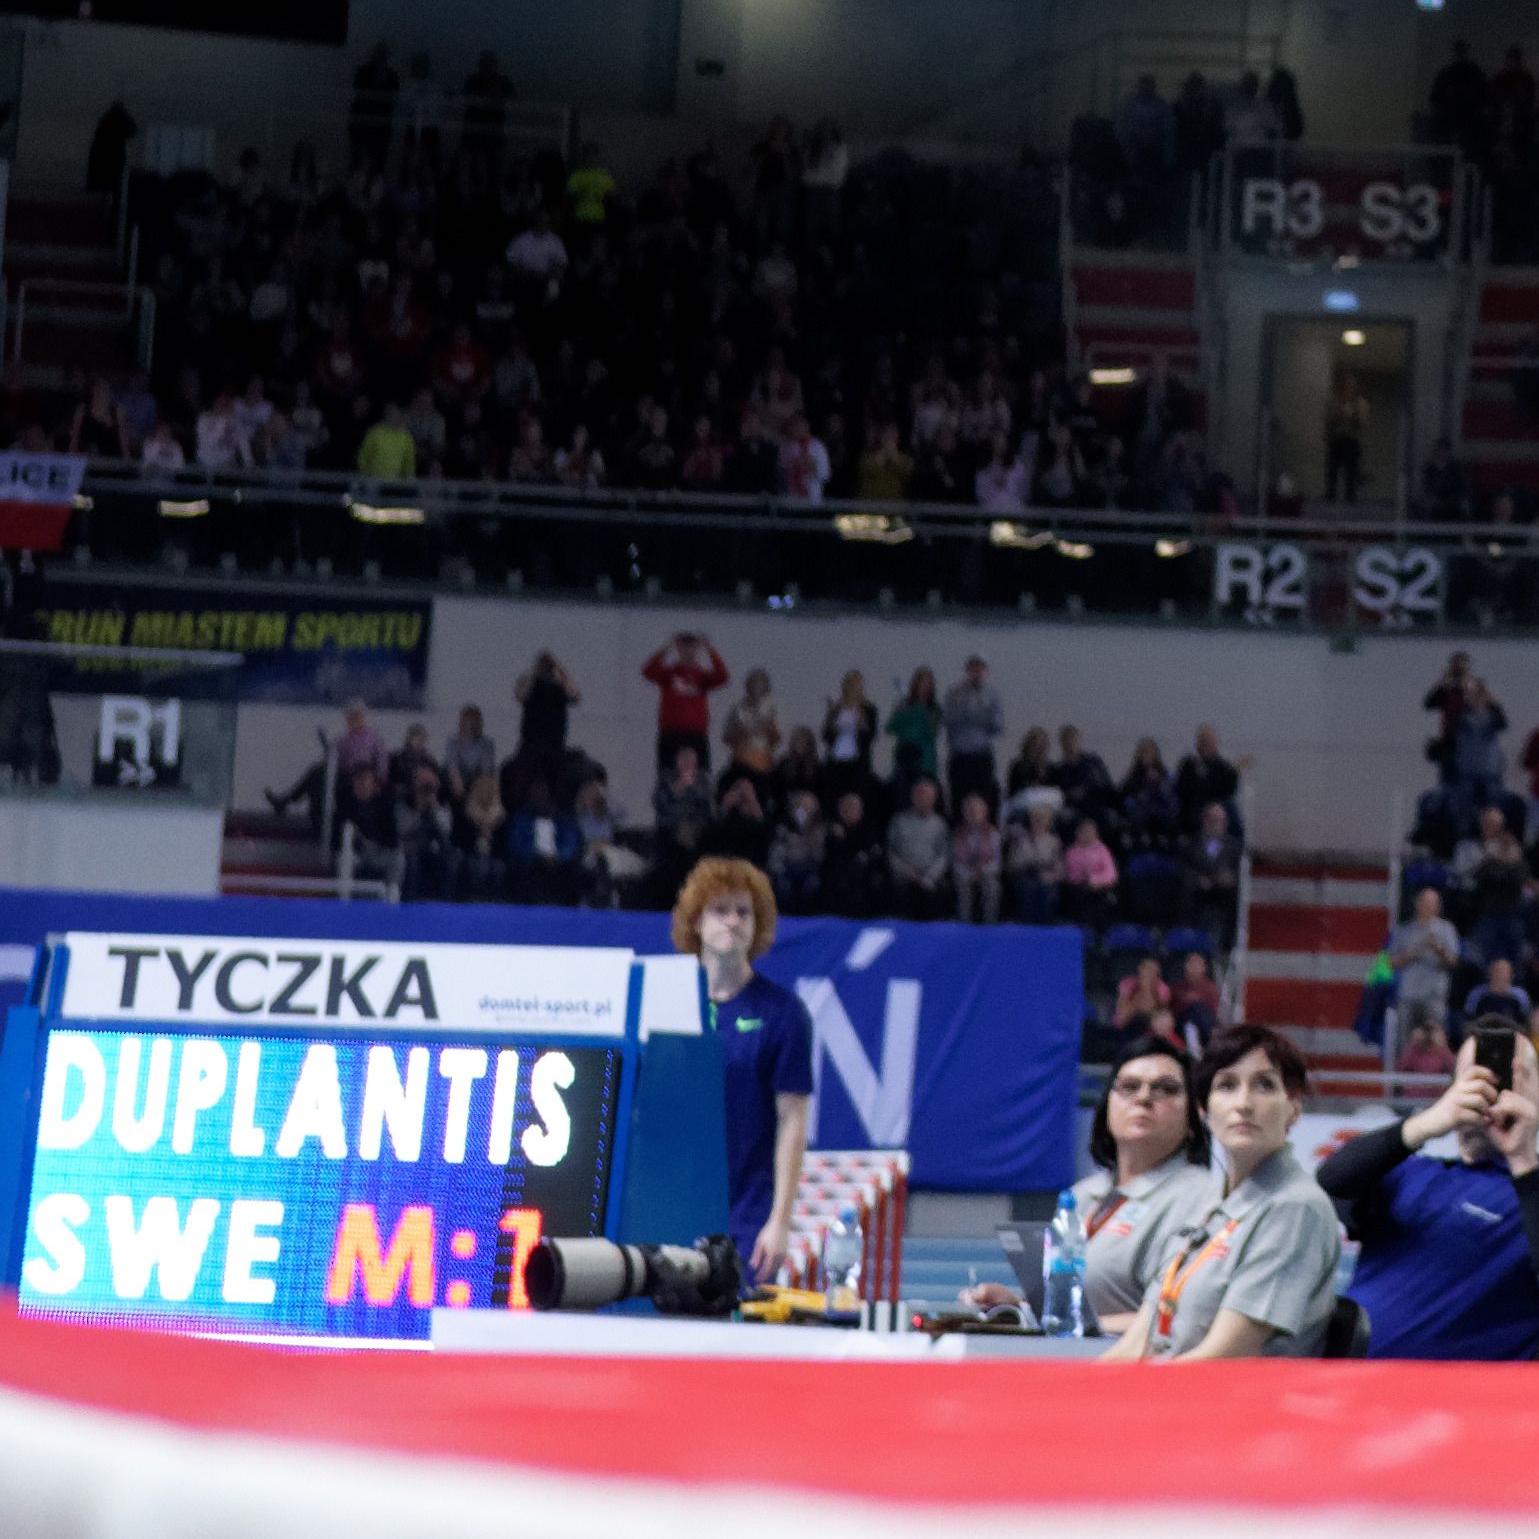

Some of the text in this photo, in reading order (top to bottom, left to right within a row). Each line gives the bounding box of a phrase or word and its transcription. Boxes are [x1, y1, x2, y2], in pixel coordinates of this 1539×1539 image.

[1241, 178, 1444, 243] R3 S3
[1215, 545, 1444, 612] R2 S2
[99, 695, 183, 769] R1
[107, 946, 440, 1020] TYCZKA
[36, 1032, 576, 1166] DUPLANTIS
[22, 1192, 286, 1303] SWE
